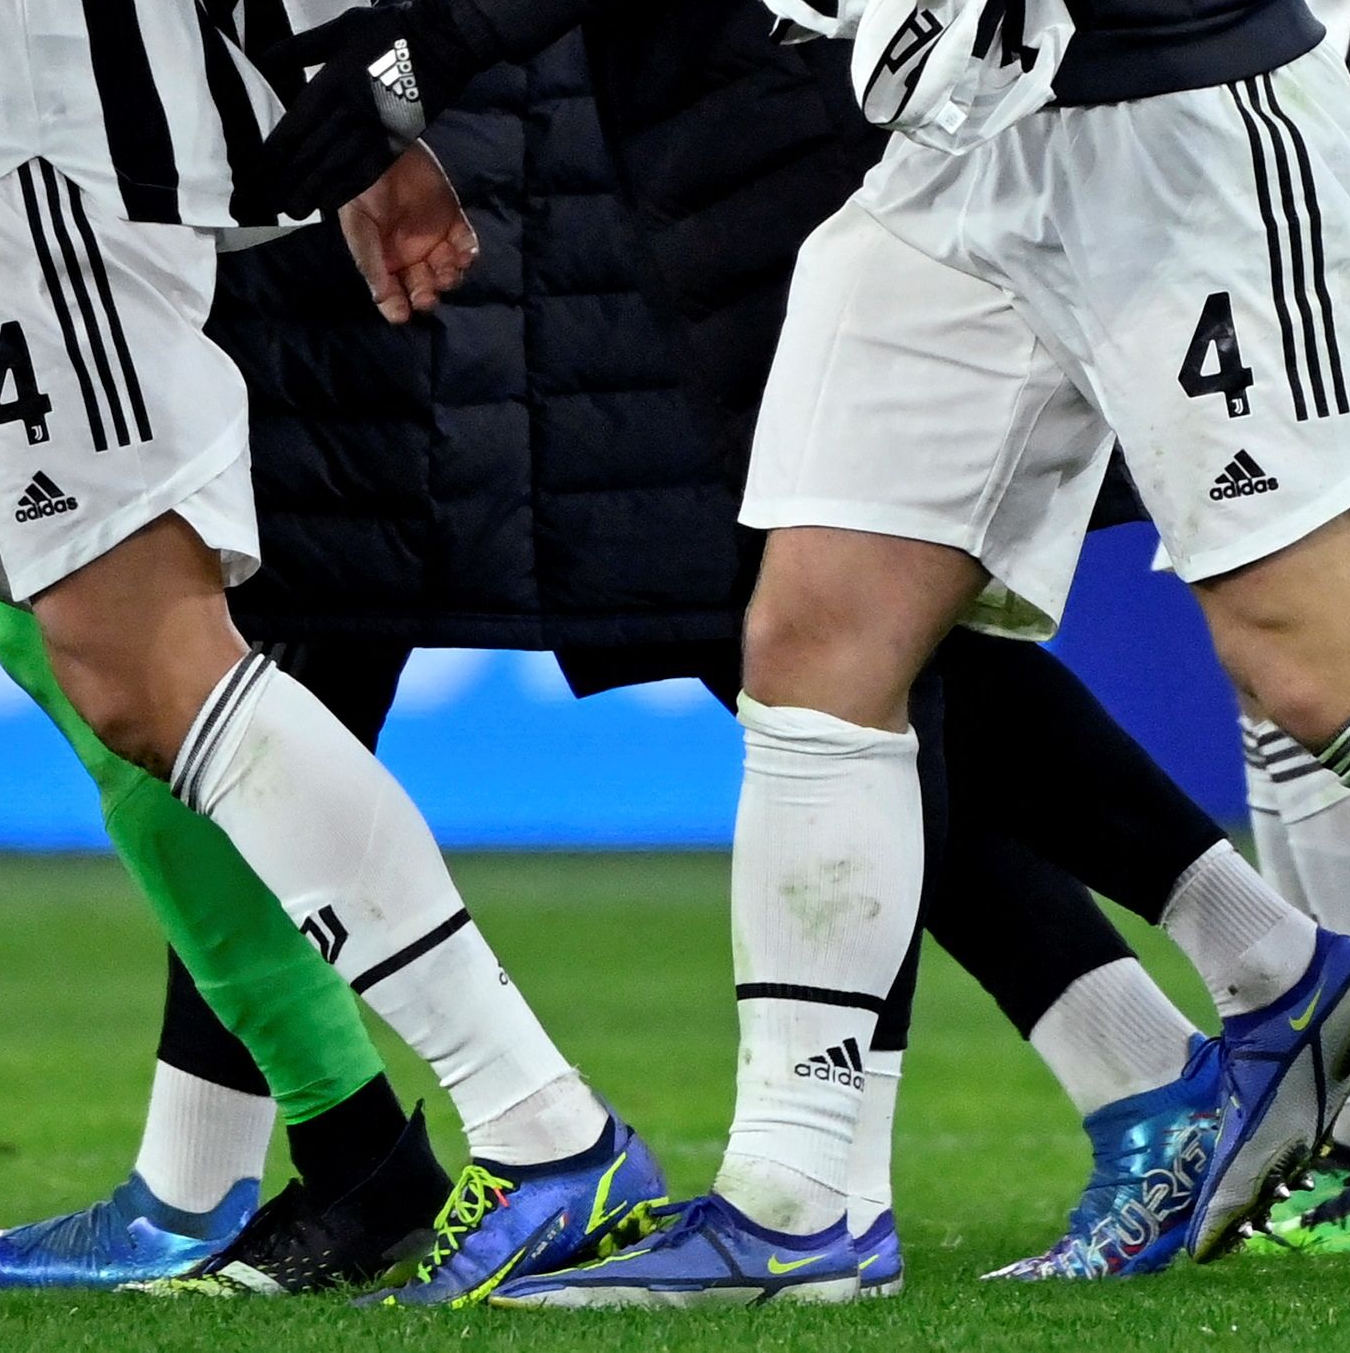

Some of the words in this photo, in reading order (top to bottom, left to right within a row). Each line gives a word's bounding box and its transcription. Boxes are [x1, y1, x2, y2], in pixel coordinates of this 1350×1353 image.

[1178, 291, 1254, 418] 4
[1209, 475, 1279, 501] adidas
[15, 496, 78, 523] adidas
